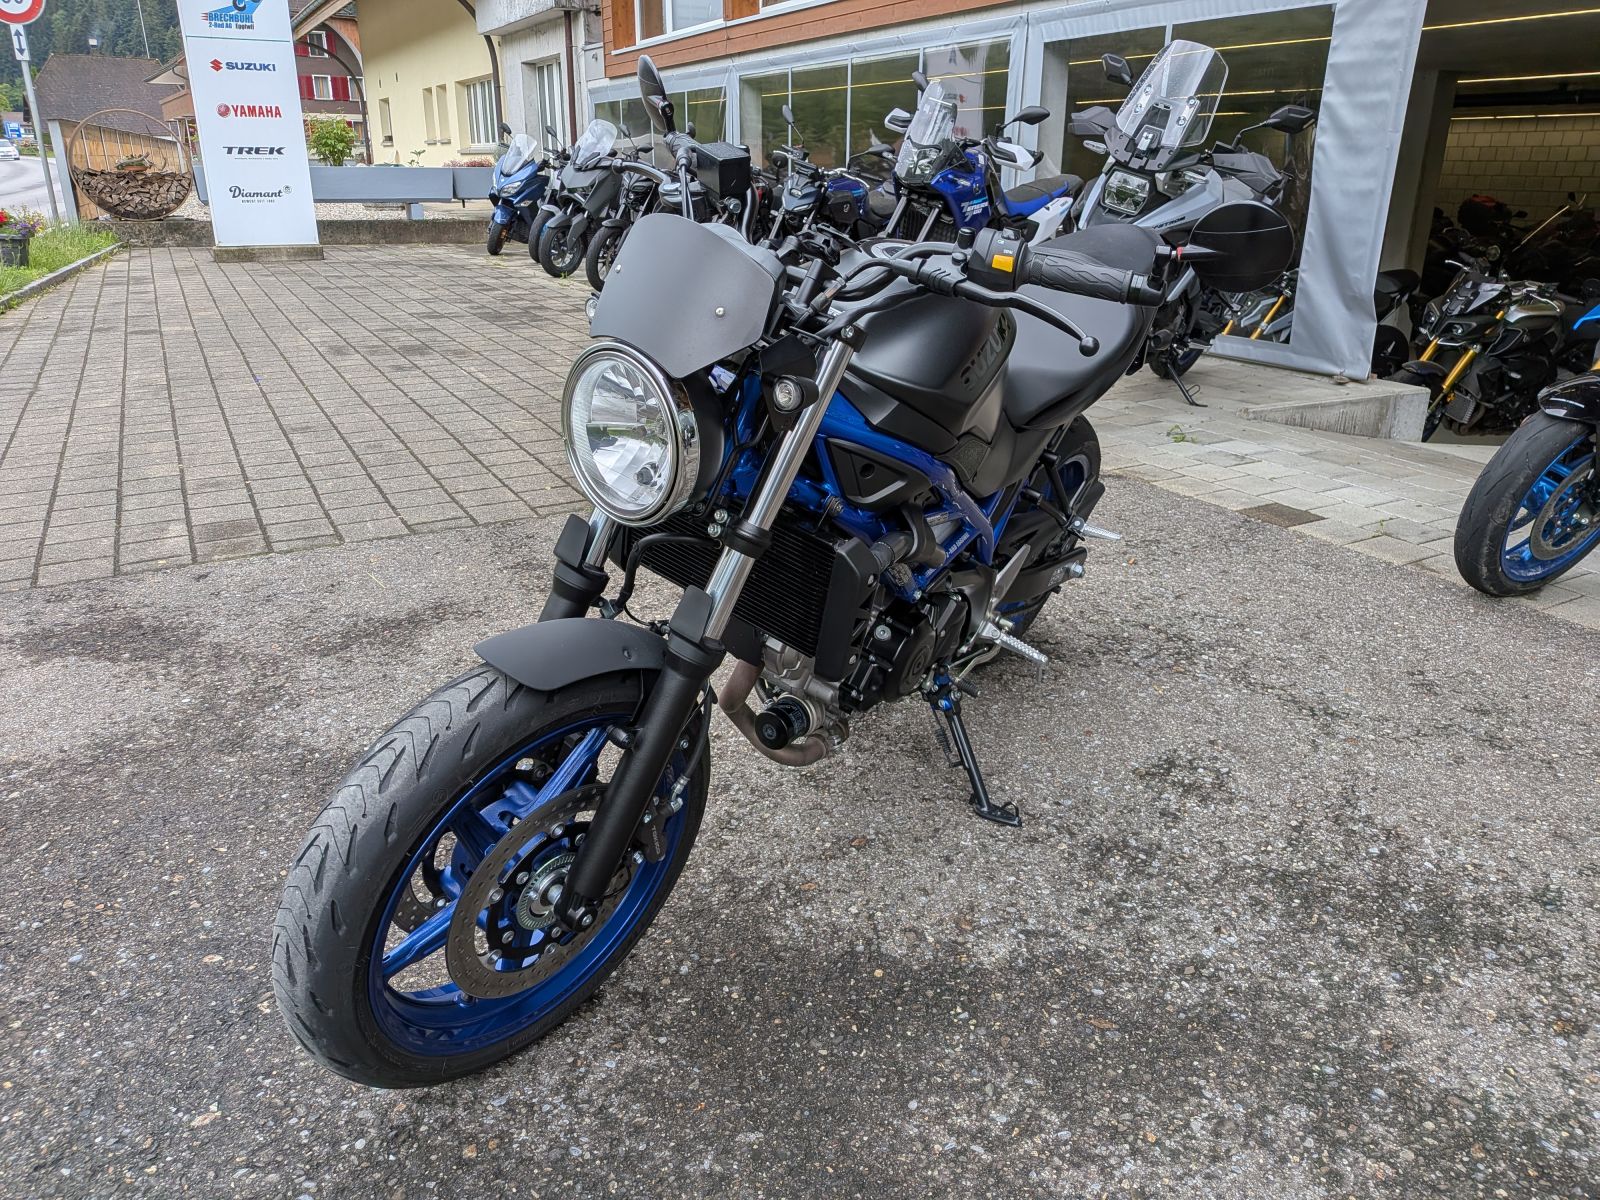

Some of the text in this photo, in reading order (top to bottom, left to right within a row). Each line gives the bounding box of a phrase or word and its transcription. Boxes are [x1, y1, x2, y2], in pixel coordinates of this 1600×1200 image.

[225, 62, 276, 71] SUZUKI
[231, 104, 282, 118] YAMAHA
[222, 146, 286, 155] TREK
[229, 185, 283, 198] Diamant
[959, 312, 1011, 392] SUZUKI
